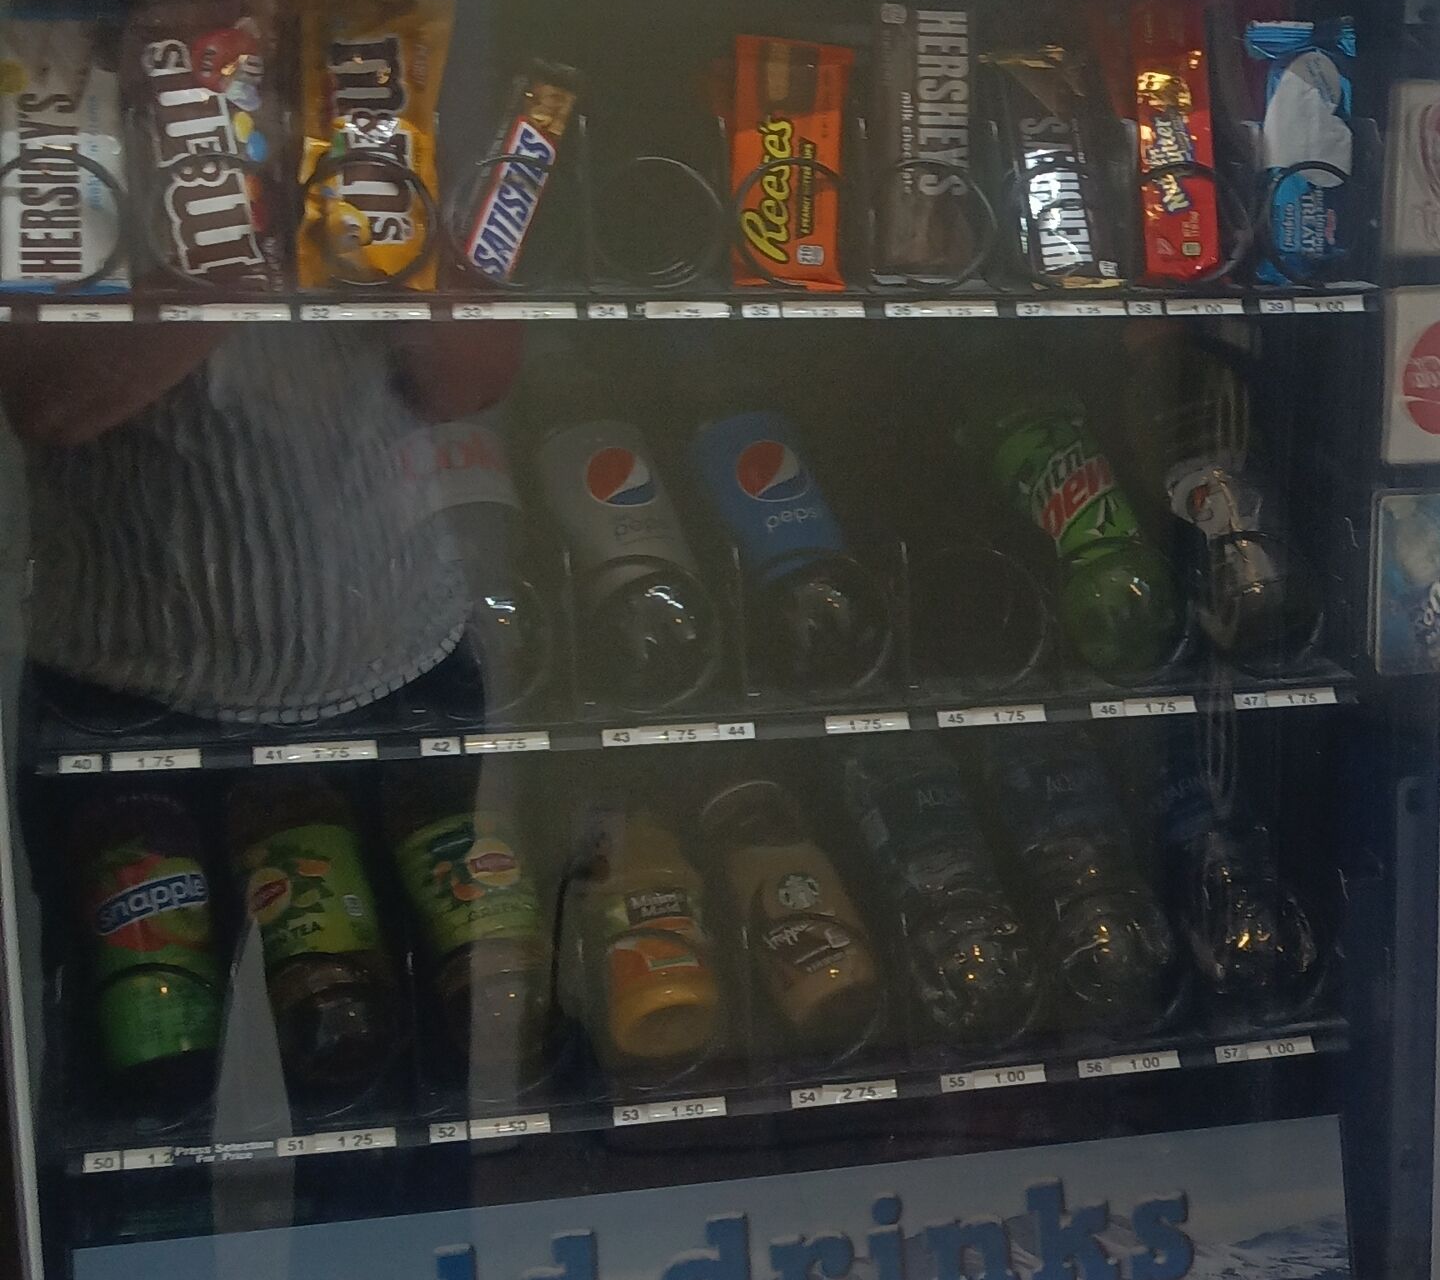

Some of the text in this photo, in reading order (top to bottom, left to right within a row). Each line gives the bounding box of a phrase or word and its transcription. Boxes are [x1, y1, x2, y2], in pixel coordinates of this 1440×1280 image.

[917, 9, 970, 196] HERSHEYS
[898, 125, 915, 195] choclate
[752, 306, 769, 317] 35
[1025, 304, 1041, 315] 37
[1268, 301, 1283, 312] 39
[766, 506, 822, 534] peps
[1242, 693, 1319, 707] 47 1.75
[1099, 701, 1177, 715] 46 1.75
[947, 710, 1026, 725] 45 1.75
[612, 731, 631, 743] 43
[728, 725, 746, 737] 44
[431, 741, 450, 753] 42
[265, 749, 283, 761] 41
[71, 757, 93, 770] 40
[1223, 1043, 1296, 1059] 57 1.00
[1086, 1057, 1160, 1073] 56 1.00
[949, 1071, 1026, 1089] 55 1.00
[799, 1088, 877, 1104] 54 2.75
[621, 1104, 705, 1122] 53 1.50
[436, 1127, 457, 1139] 52
[287, 1140, 306, 1151] 51
[93, 1157, 114, 1170] 50
